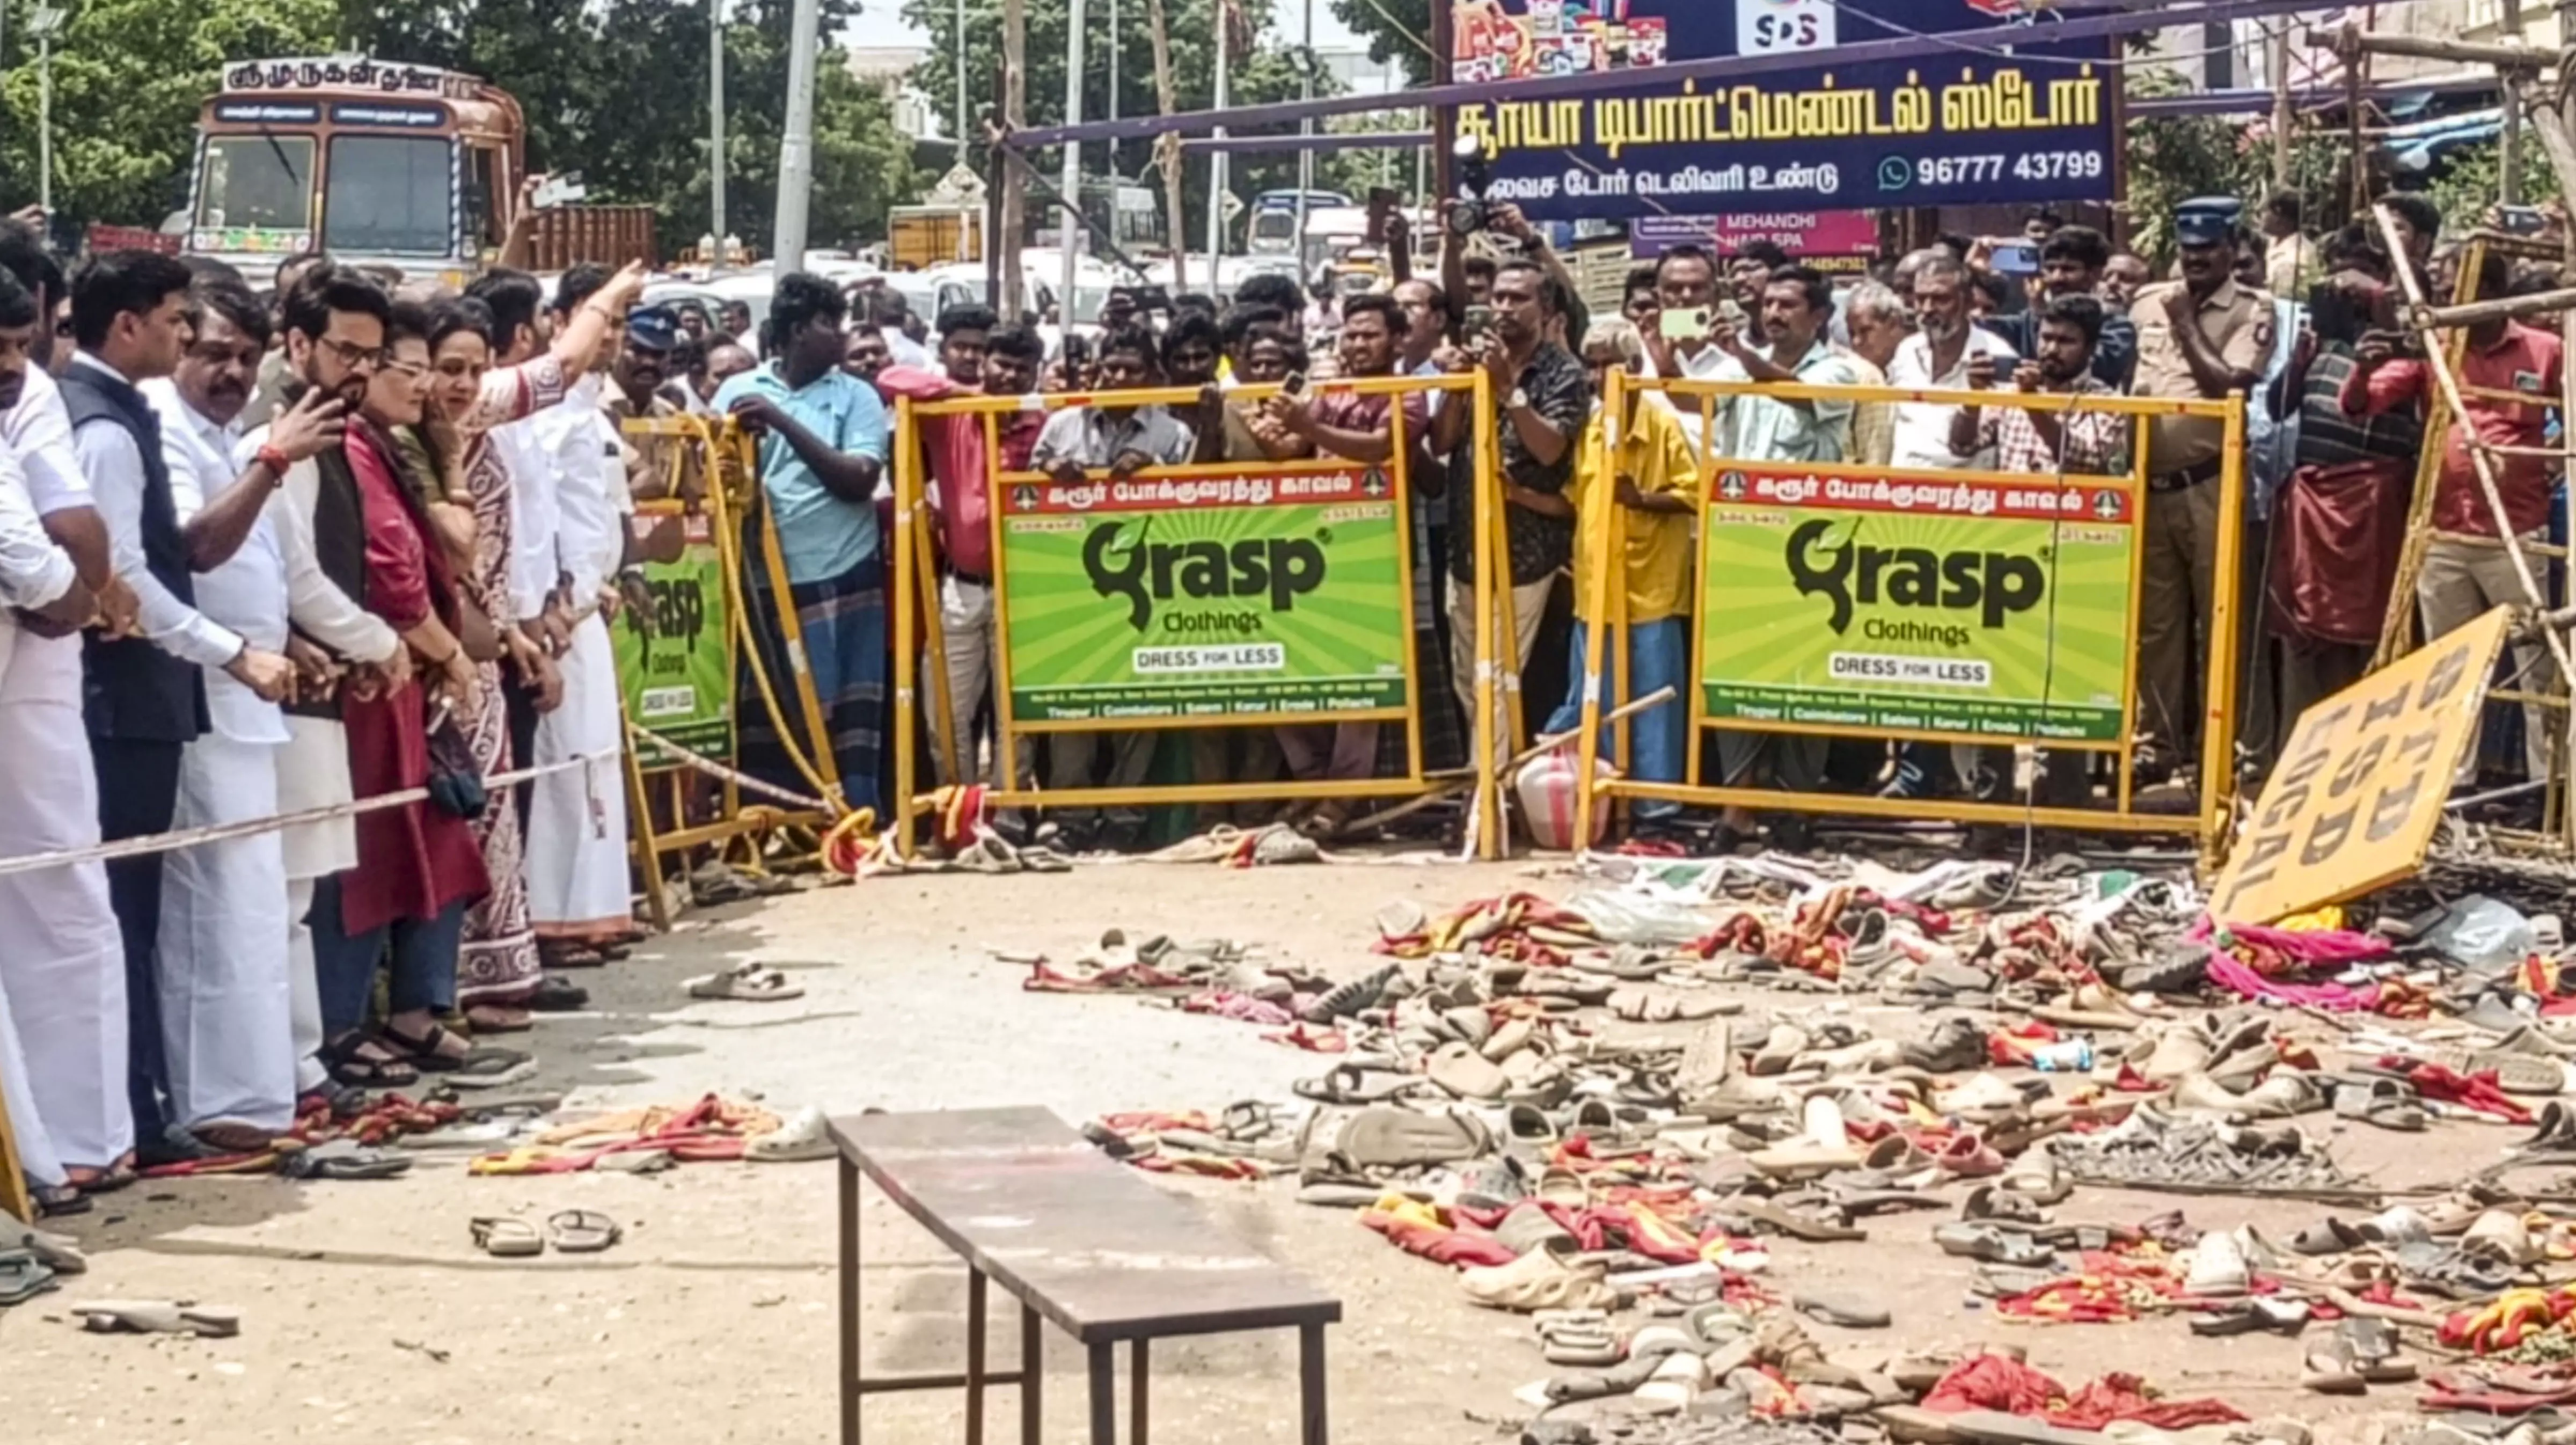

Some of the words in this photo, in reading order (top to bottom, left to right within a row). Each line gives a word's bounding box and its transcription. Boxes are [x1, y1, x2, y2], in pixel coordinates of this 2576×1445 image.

[1594, 69, 1931, 159] டிபார்ட்மெண்டல்
[1941, 62, 2101, 131] ஸ்டோர்
[1564, 167, 1630, 196] டோர்
[1635, 163, 1745, 194] டெலிவரி
[1748, 161, 1839, 194] உண்டு
[1917, 155, 2006, 185] 96777
[2012, 150, 2103, 181] 43799
[1726, 212, 1817, 228] MEHANDHI
[1771, 232, 1805, 247] SPA
[1048, 481, 1107, 509] கரூர்
[1113, 475, 1274, 504] போக்குவரத்து
[1279, 470, 1352, 494] காவல்
[1756, 473, 1820, 503] கரூர்
[1825, 477, 1997, 515] போக்குவரத்து
[2003, 487, 2083, 511] காவல்
[1163, 610, 1263, 634] Clothings
[1864, 618, 1971, 647] Clothings
[1137, 650, 1198, 668] DRESS
[1203, 649, 1230, 663] FOR
[1234, 647, 1279, 665] LESS
[1834, 656, 1897, 676] DRESS
[1904, 662, 1931, 676] FOR
[1937, 662, 1986, 682] LESS
[2300, 681, 2412, 866] ISD
